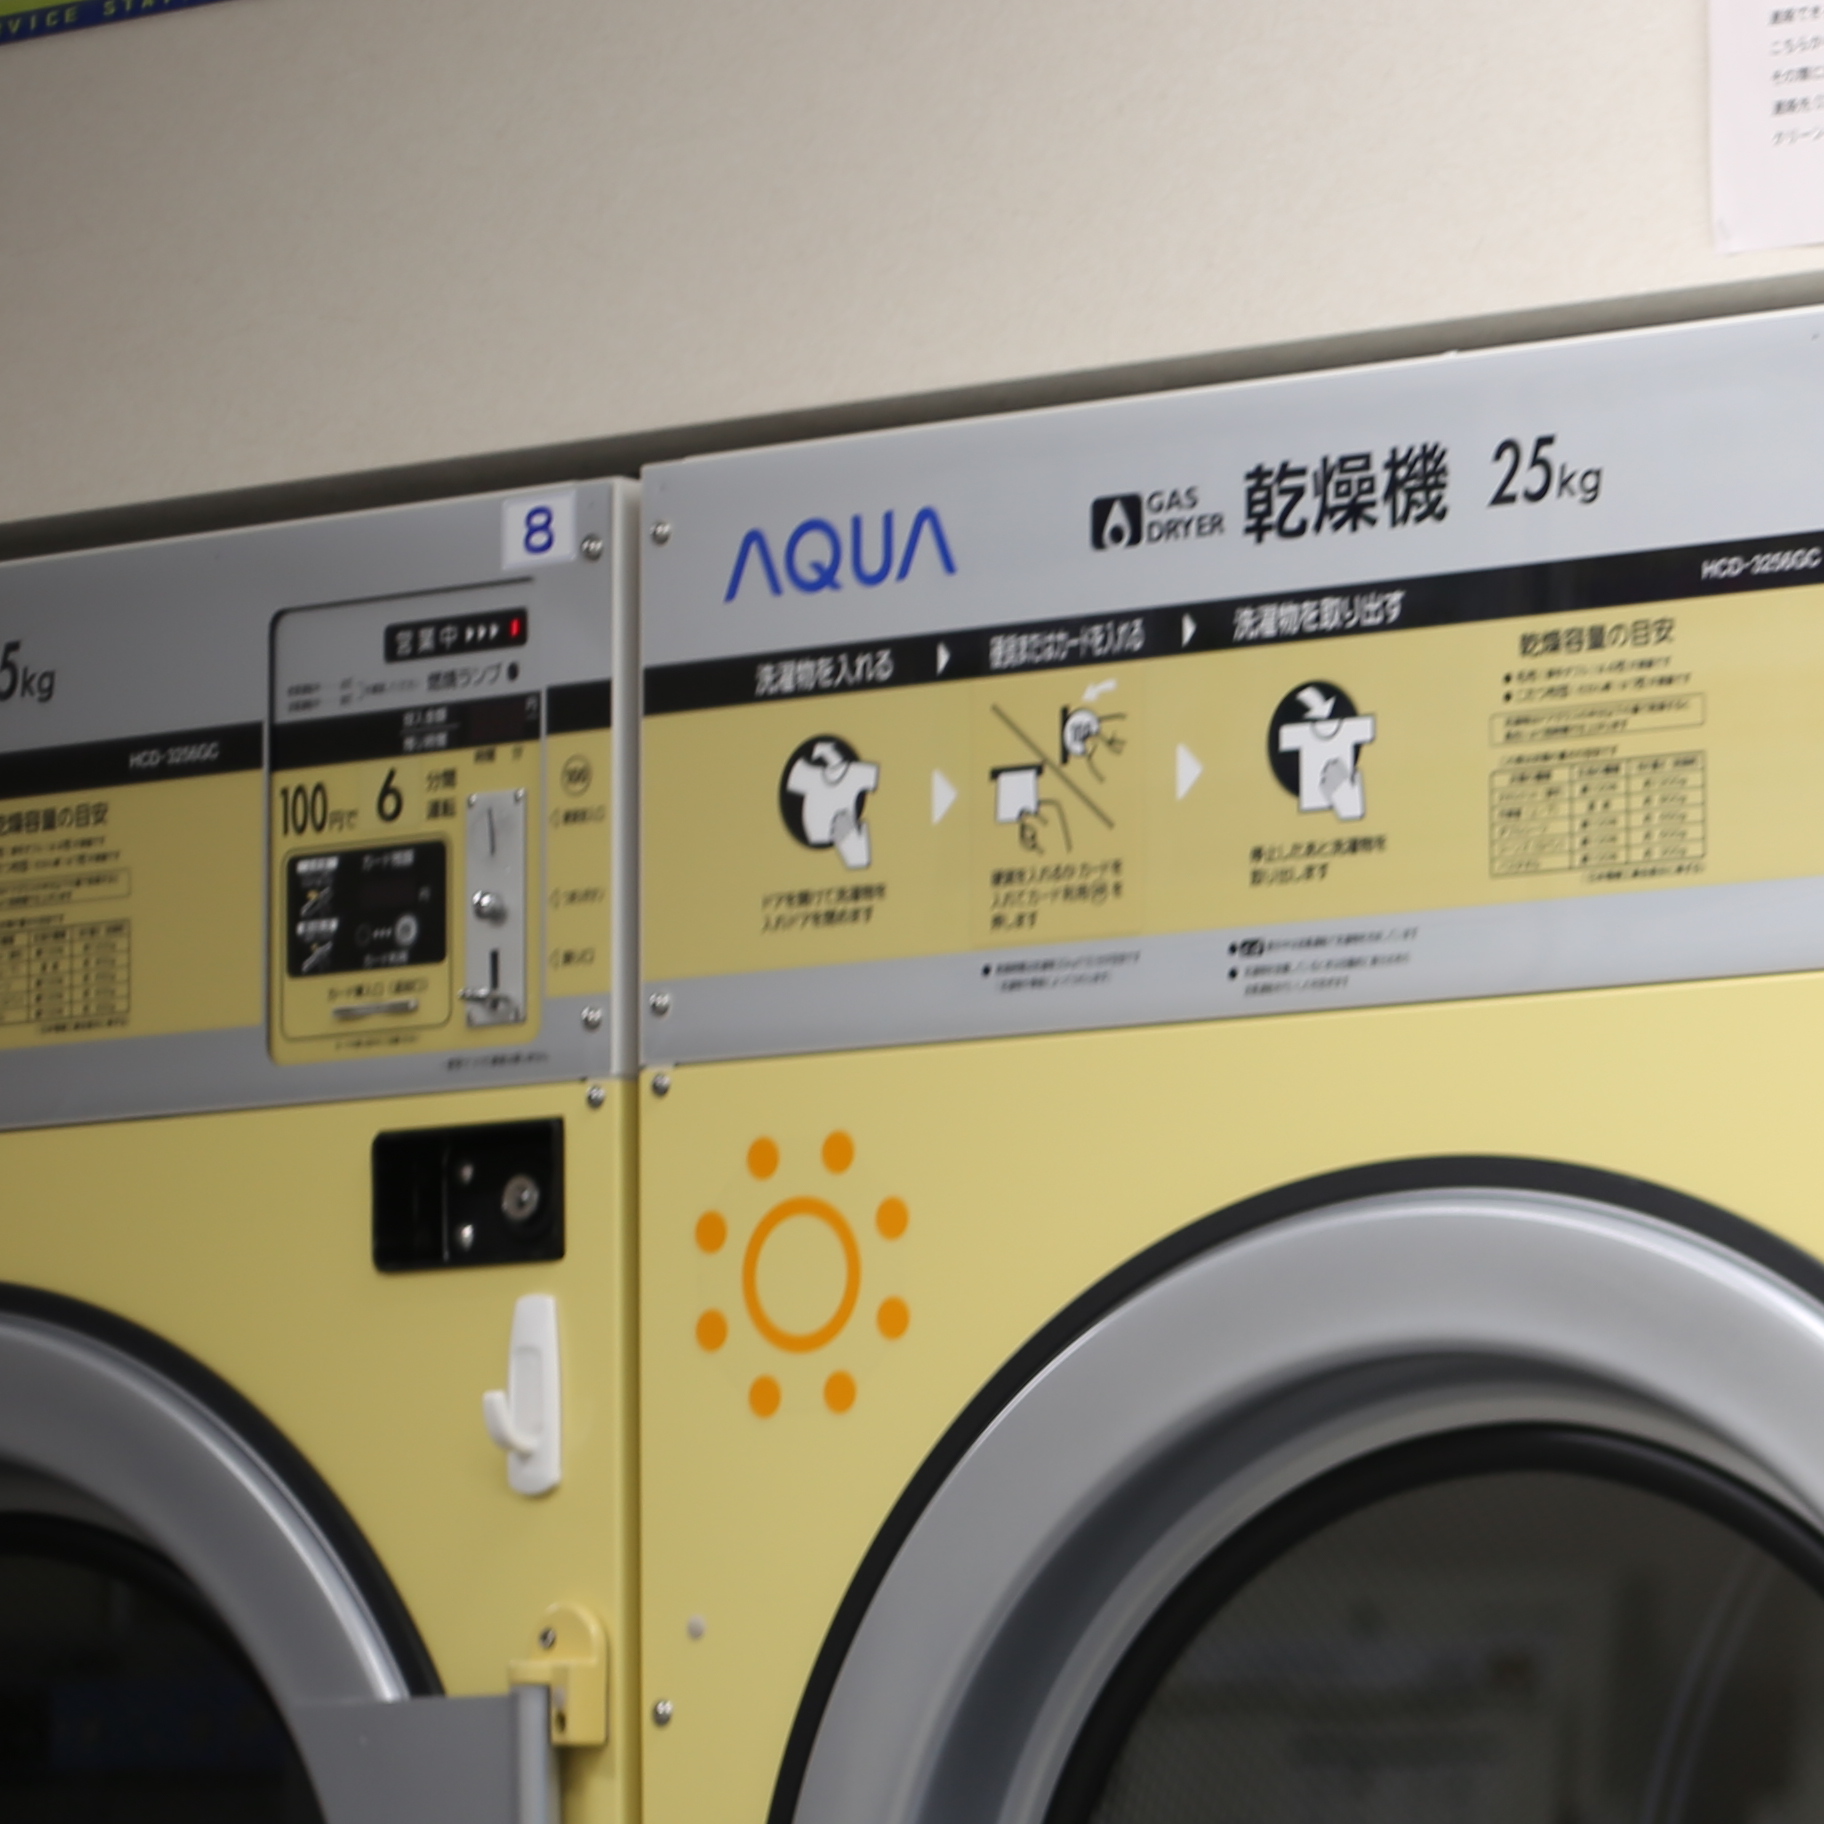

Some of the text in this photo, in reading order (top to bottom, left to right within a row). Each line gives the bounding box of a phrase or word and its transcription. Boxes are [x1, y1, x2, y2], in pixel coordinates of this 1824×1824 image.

[1147, 488, 1199, 512] GAS
[1245, 435, 1603, 543] 乾燥機 25kg
[525, 506, 554, 553] 8
[1147, 513, 1225, 542] DRYER
[724, 506, 957, 602] AQUA
[395, 625, 459, 657] 営業中
[755, 649, 895, 698] 洗濯物を入れる
[1232, 589, 1406, 643] 洗濯物を取り出す
[1520, 617, 1675, 658] 乾燥容量の目安
[377, 767, 403, 822] 6
